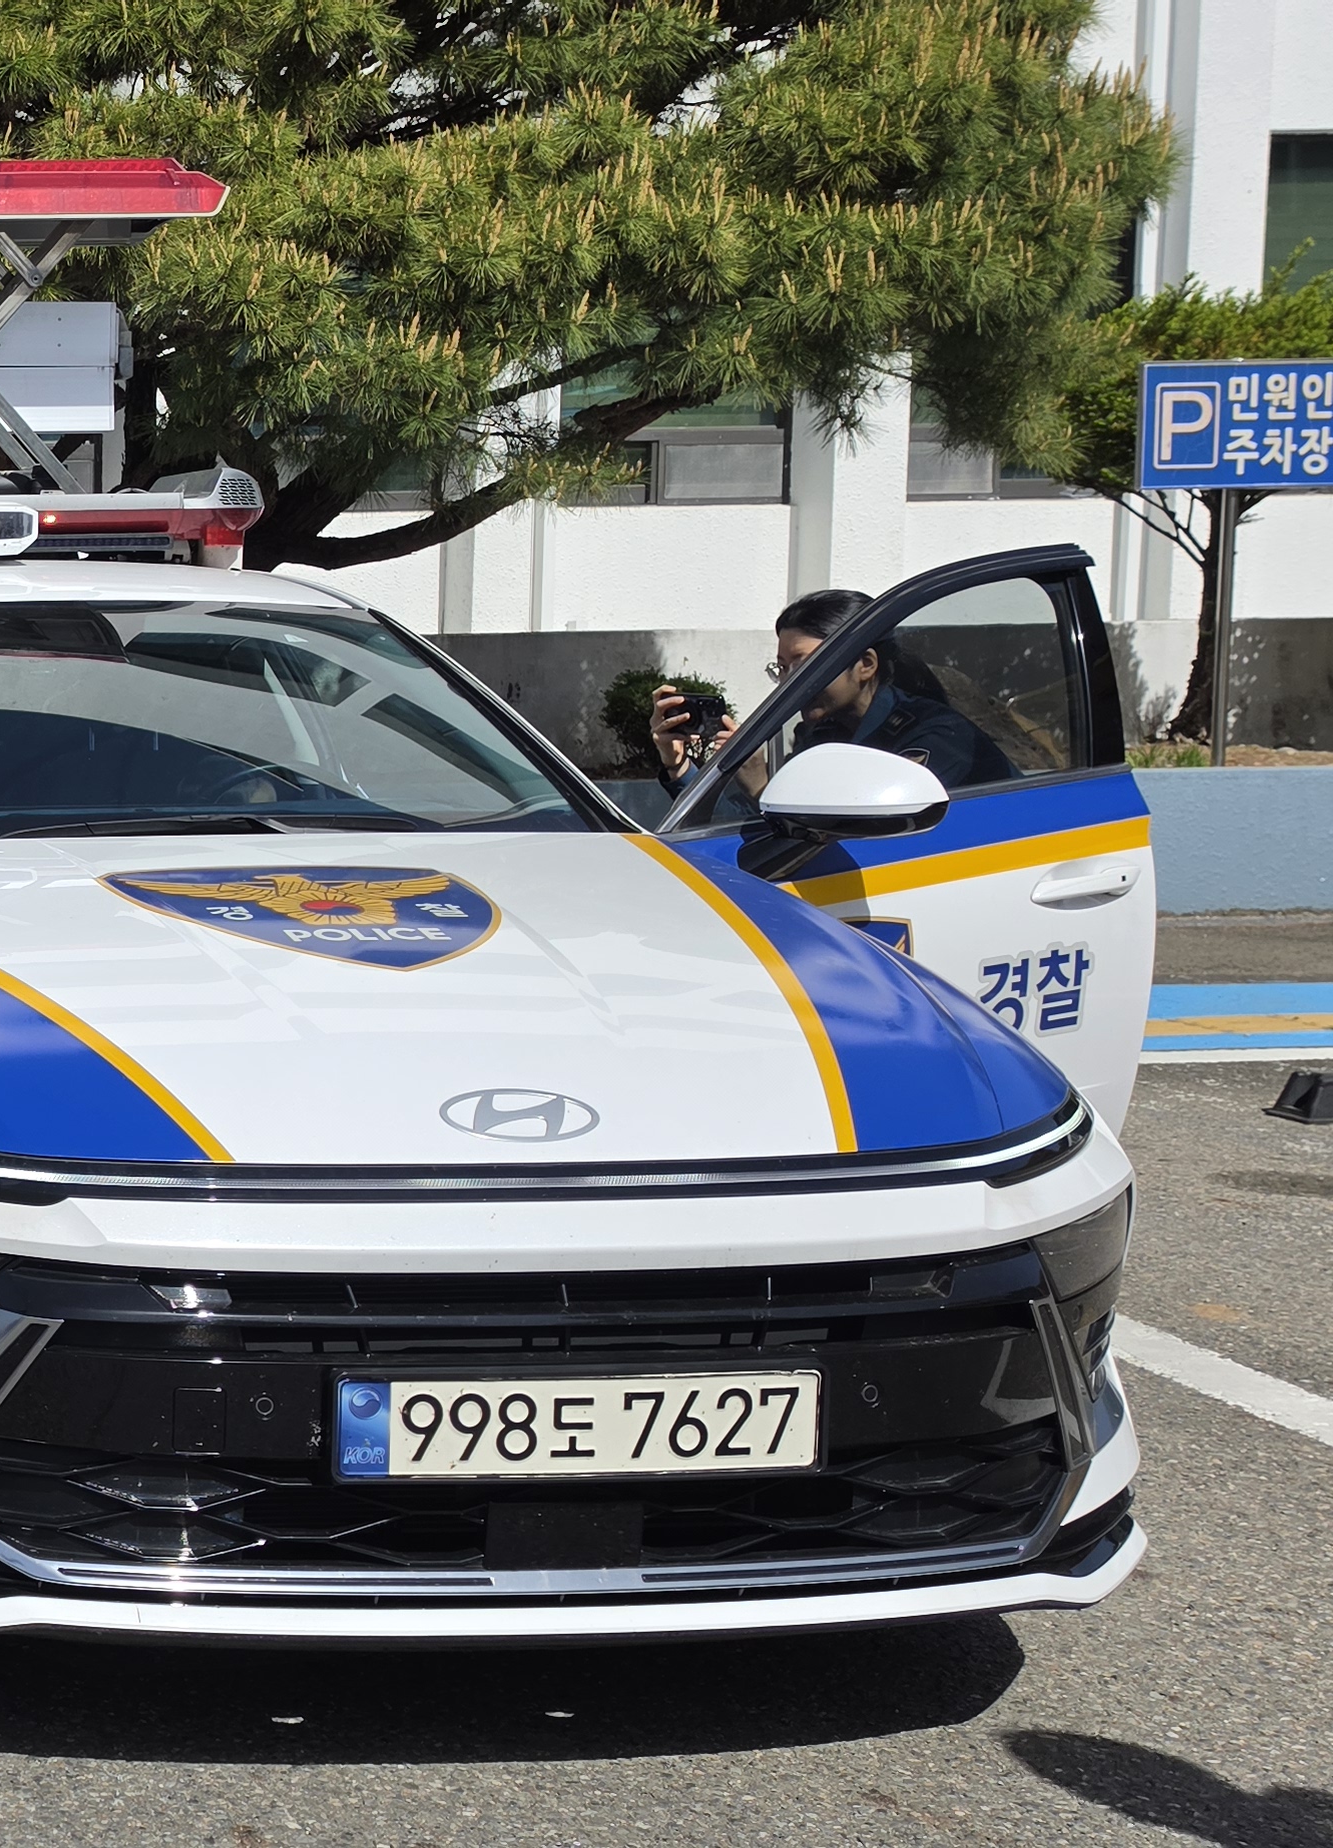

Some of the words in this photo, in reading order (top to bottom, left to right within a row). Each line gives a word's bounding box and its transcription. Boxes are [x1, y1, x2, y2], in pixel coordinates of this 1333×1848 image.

[1228, 372, 1333, 421] 민원인
[1222, 426, 1333, 475] 주차장
[283, 926, 453, 943] POLICE
[979, 948, 1091, 1031] 경찰
[401, 1391, 596, 1462] 998도
[623, 1386, 800, 1459] 7627
[343, 1446, 386, 1465] KOR
